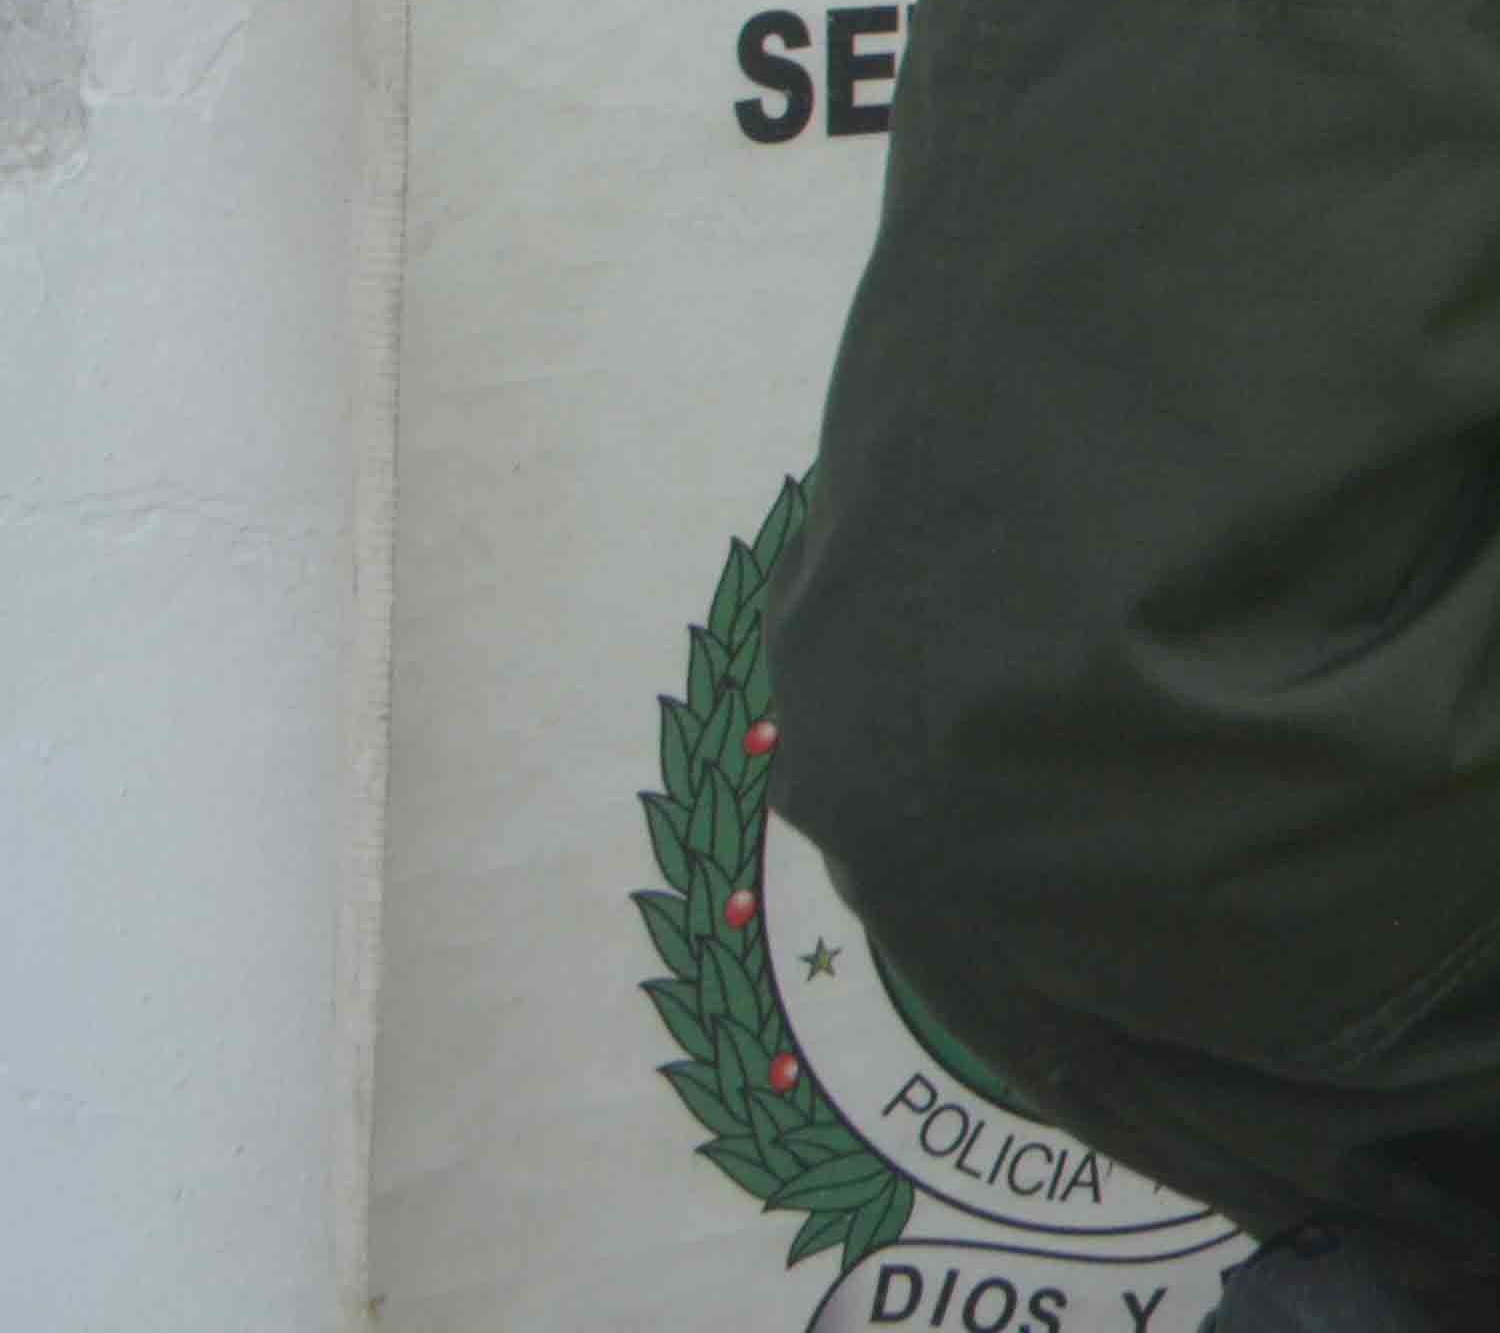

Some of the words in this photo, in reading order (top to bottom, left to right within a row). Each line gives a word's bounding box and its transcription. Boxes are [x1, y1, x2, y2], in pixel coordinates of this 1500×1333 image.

[881, 1072, 1103, 1204] POLICIA
[869, 1264, 1068, 1333] DIOS
[1122, 1287, 1169, 1333] Y
